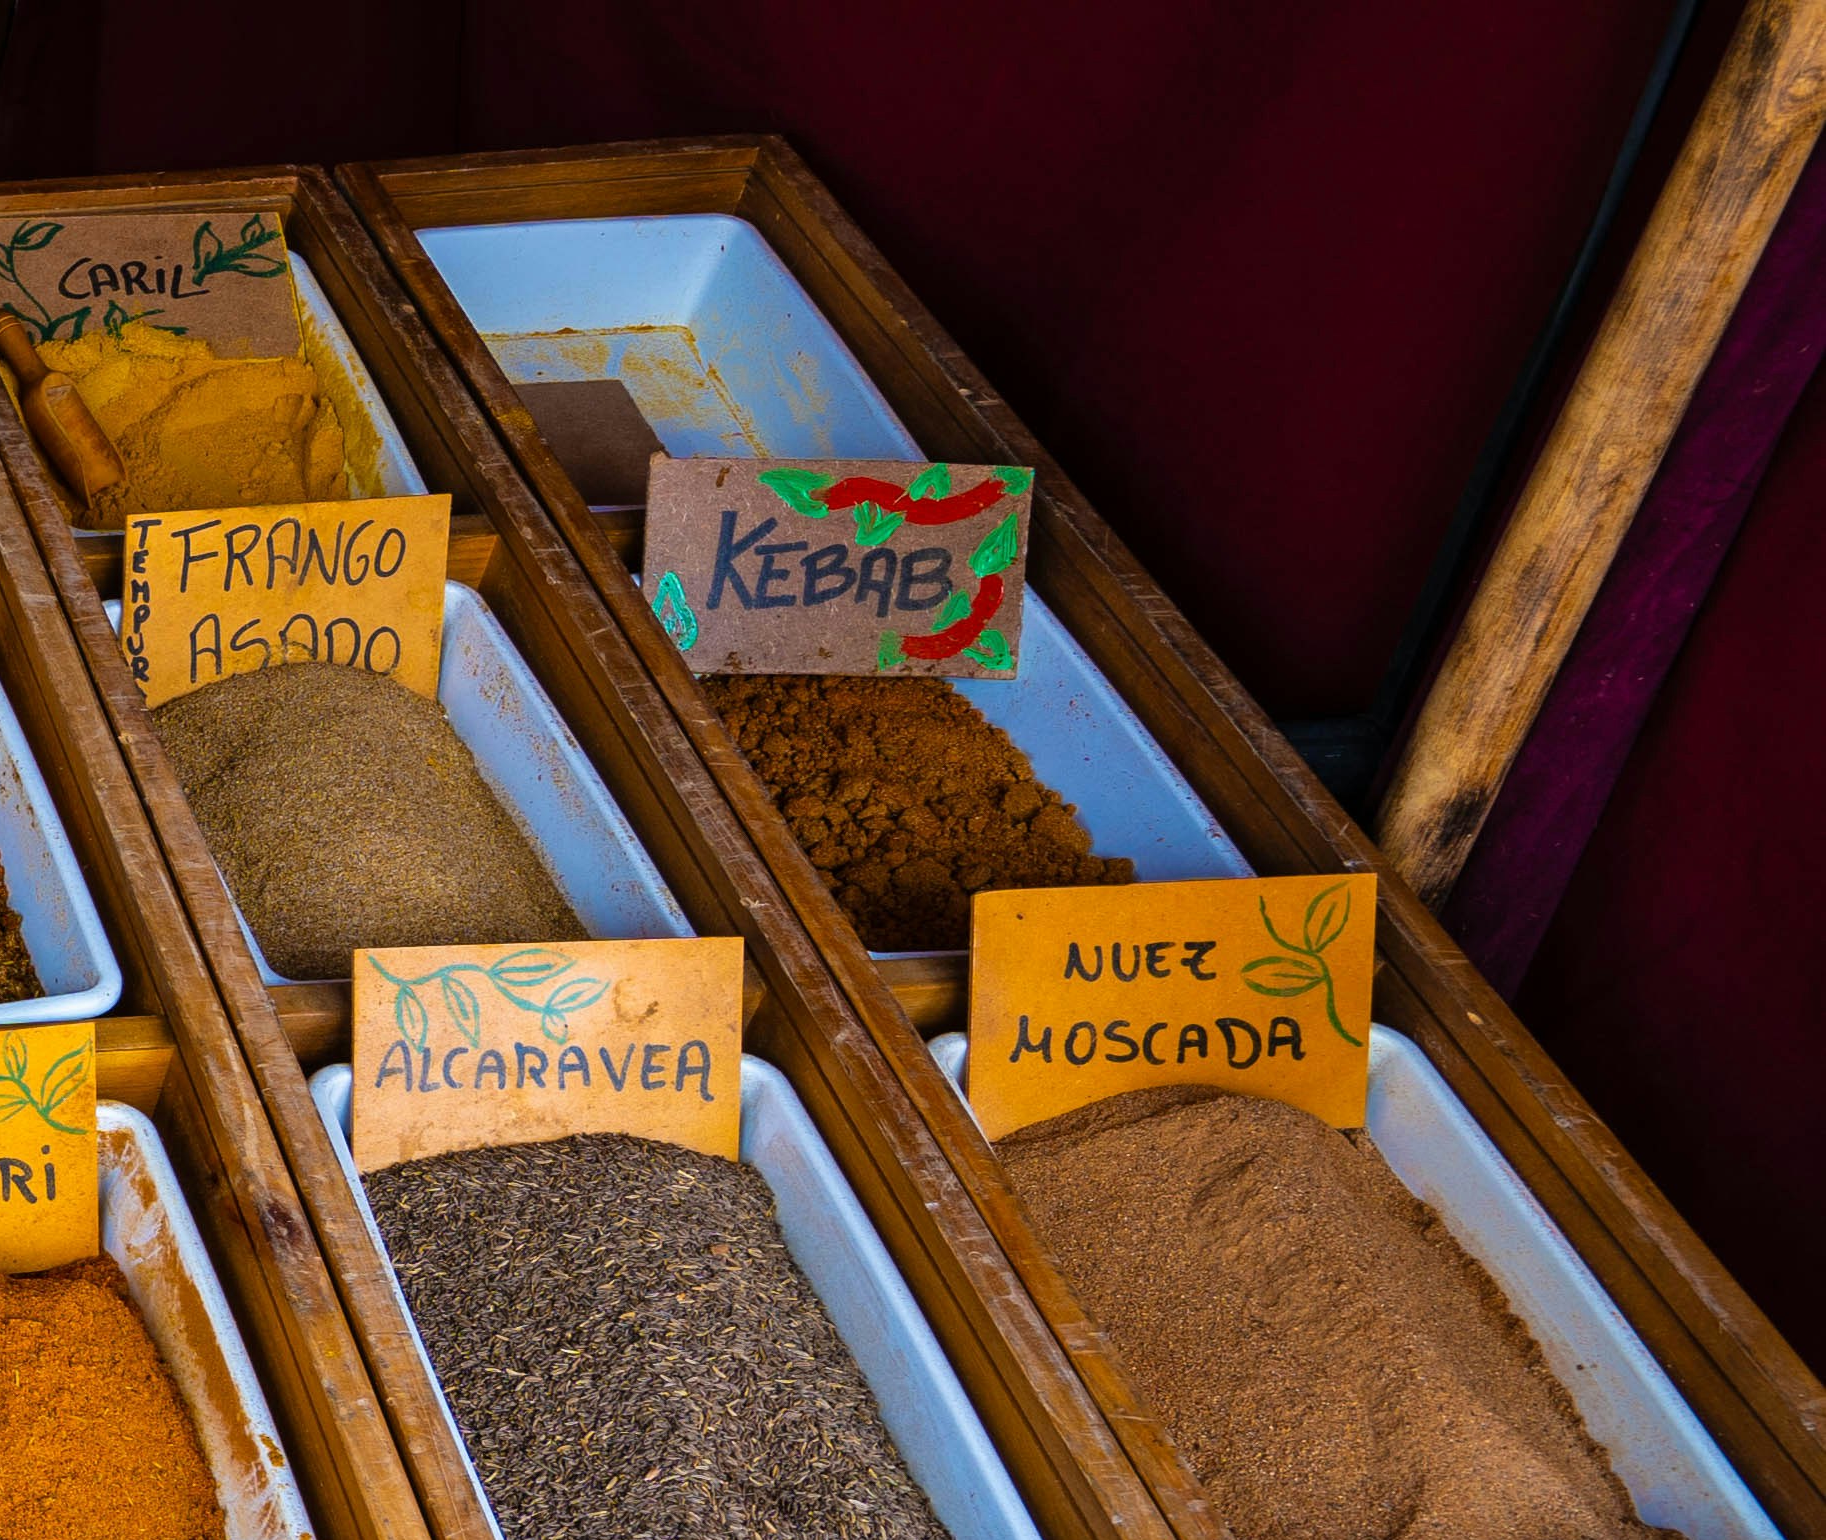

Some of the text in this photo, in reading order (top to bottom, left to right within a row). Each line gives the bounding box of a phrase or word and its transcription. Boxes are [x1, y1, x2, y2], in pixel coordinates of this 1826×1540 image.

[58, 256, 209, 299] CARIL
[170, 517, 407, 594] FRANGO
[707, 510, 955, 618] KEBAB
[190, 613, 401, 683] ASADO
[1063, 939, 1219, 982] NUEZ
[373, 1039, 715, 1103] ALCARAVEA
[1008, 1015, 1307, 1071] MOSCADA
